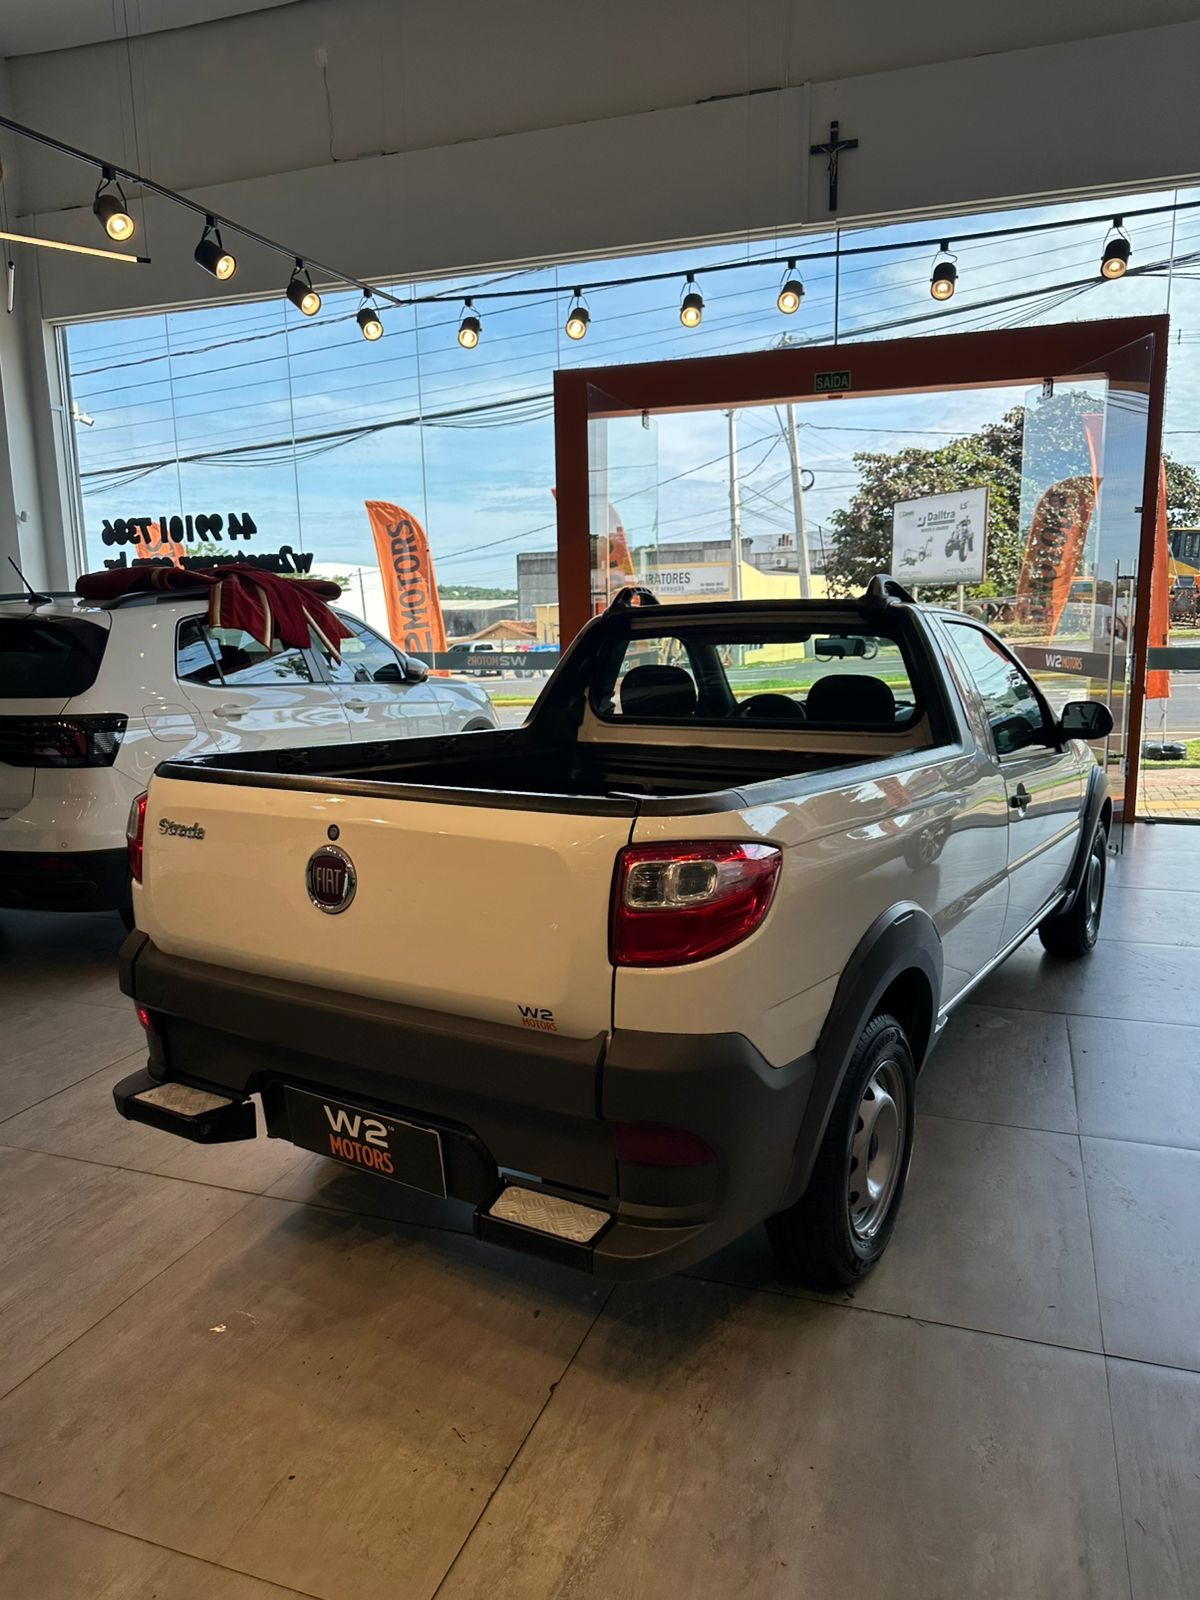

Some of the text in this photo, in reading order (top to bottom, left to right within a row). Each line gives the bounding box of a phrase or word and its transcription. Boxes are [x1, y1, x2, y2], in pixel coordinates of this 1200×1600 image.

[816, 374, 849, 390] SAÍDA
[927, 510, 956, 521] Dalltra
[1045, 654, 1062, 668] W2
[159, 818, 206, 840] Strada
[316, 867, 342, 895] FIAT
[517, 1004, 554, 1021] W2
[521, 1017, 558, 1031] MOTORS
[323, 1104, 389, 1148] W2
[329, 1133, 394, 1174] MOTORS
